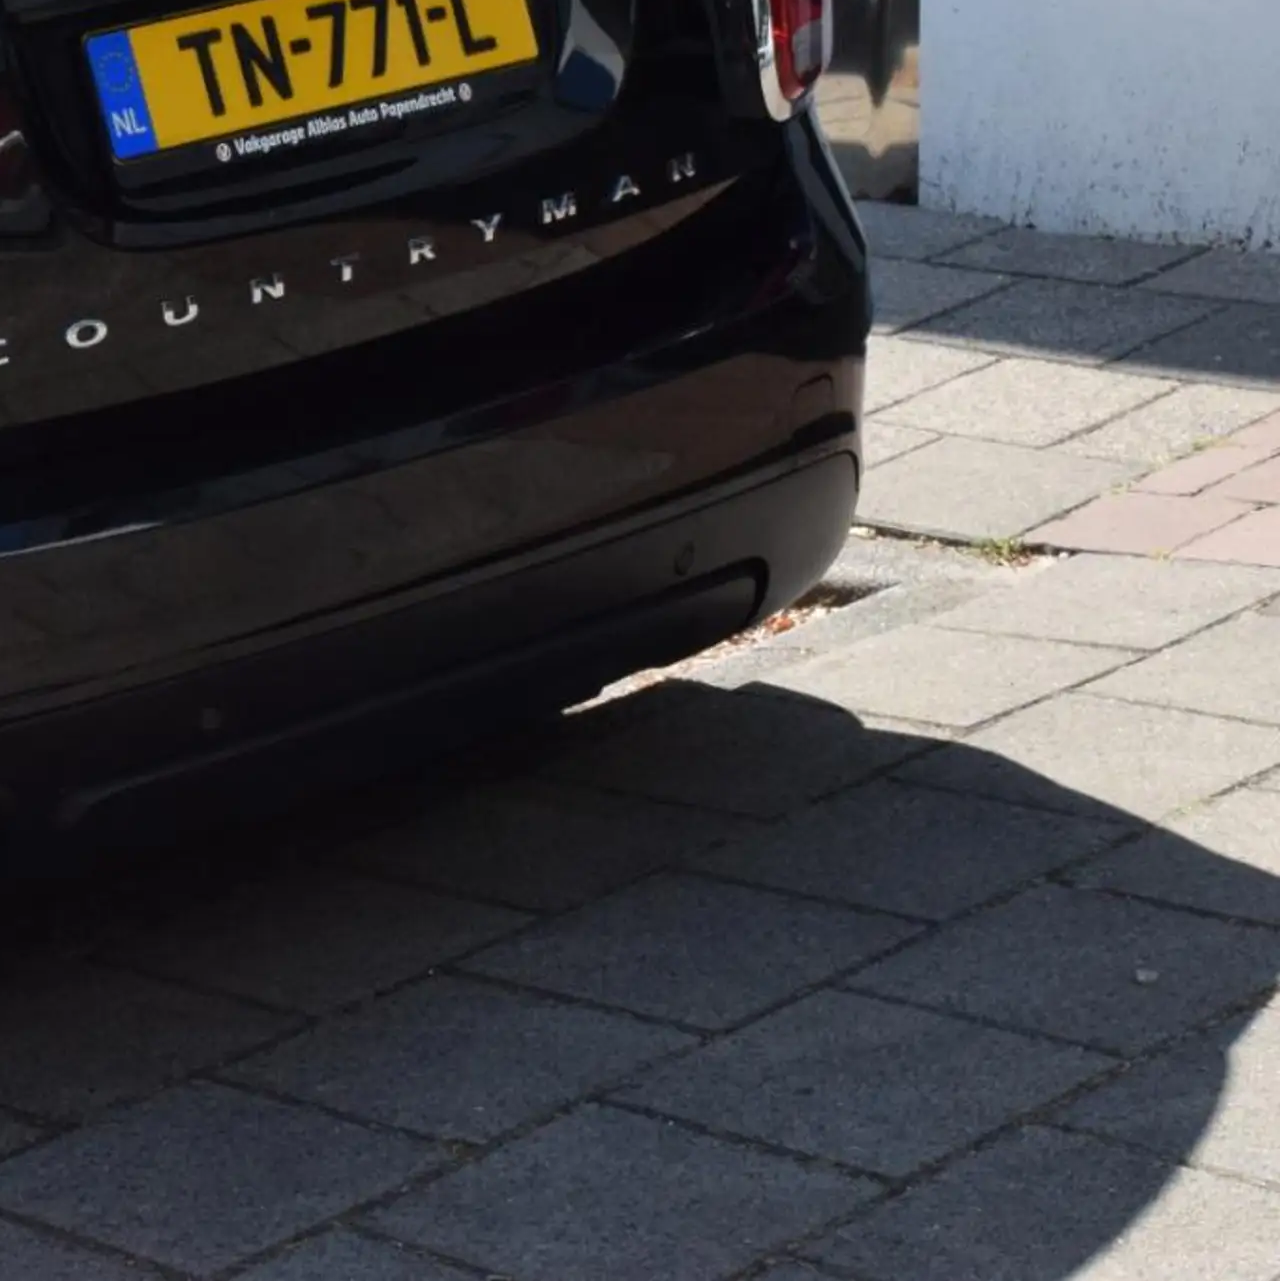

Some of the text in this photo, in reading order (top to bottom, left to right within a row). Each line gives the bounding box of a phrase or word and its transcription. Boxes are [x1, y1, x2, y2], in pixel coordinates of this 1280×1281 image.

[110, 111, 147, 137] NL
[233, 86, 456, 155] Vakgarage Alblas Auto Papendrecht
